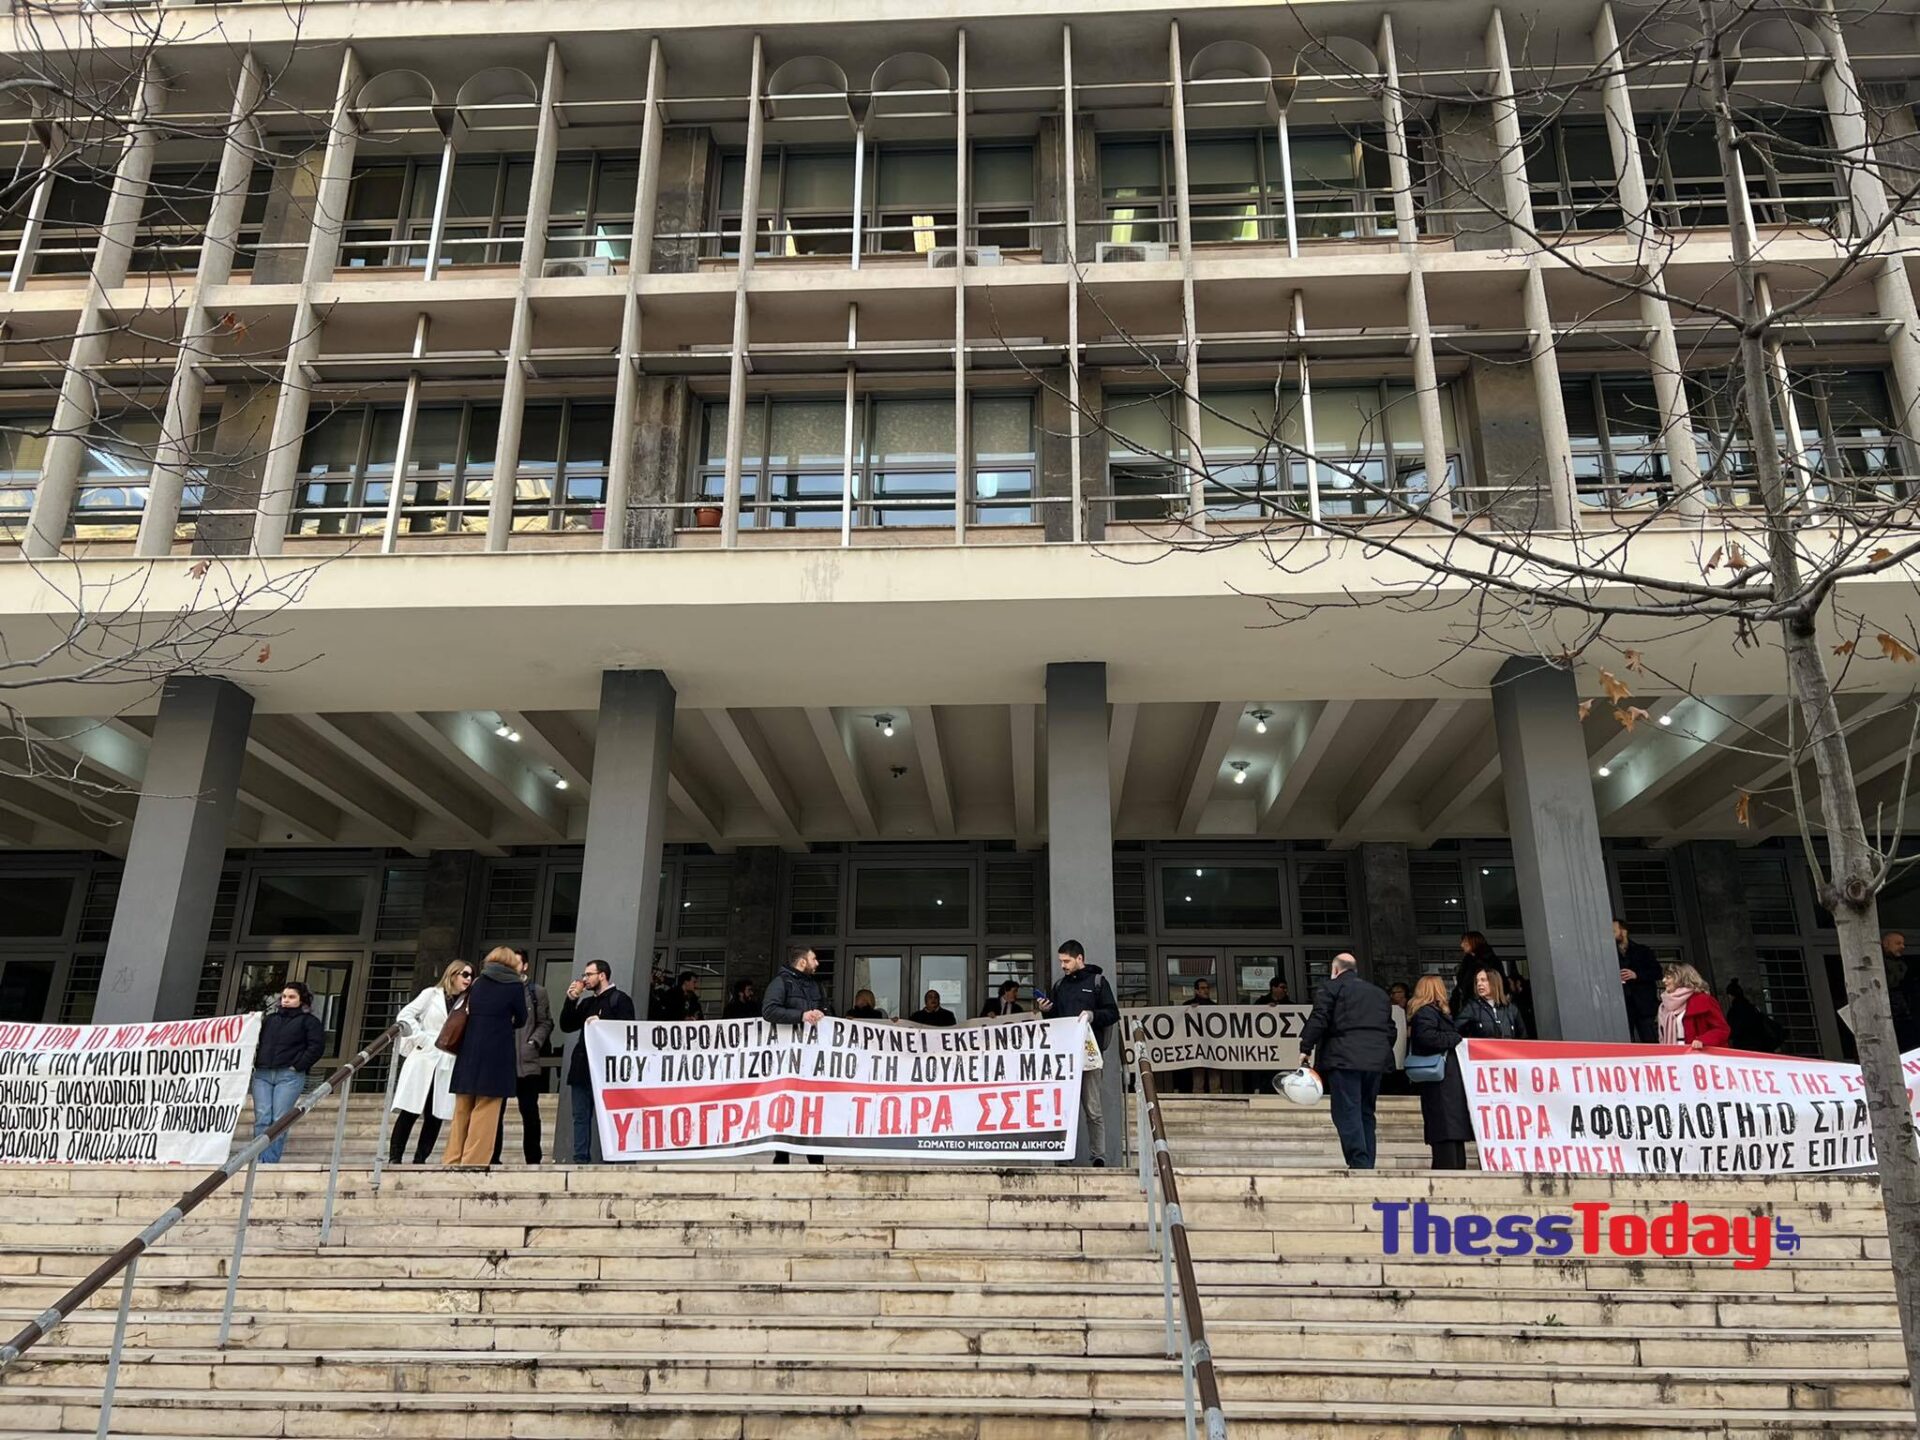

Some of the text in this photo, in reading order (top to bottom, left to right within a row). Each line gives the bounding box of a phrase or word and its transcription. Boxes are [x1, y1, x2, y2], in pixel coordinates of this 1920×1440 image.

[82, 1026, 109, 1050] ΤΟ
[105, 1025, 145, 1049] ΝΕΟ
[626, 1020, 1051, 1053] Η ΦΟΡΟΛΟΓΙΑ ΝΑ ΒΑΡΥΝΕΙ ΕΚΕΙΝΟΥΣ
[48, 1052, 81, 1076] ΤΗΝ
[83, 1051, 142, 1076] ΜΑΥΡΗ
[147, 1048, 241, 1075] ΠΡΟΟΠΤΙΚΗ
[605, 1049, 1075, 1083] ΠΟΥ ΠΛΟΥΤΙΖΟΥΝ ΑΠΟ ΤΗ ΔΟΥΛΕΙΑ ΜΑΣ!
[1151, 1044, 1280, 1063] ΘΕΣΣΑΛΟΝΙΚΗΣ
[1476, 1067, 1517, 1093] ΔΕΝ
[1531, 1066, 1560, 1093] ΘΑ
[1572, 1065, 1681, 1093] ΓΙΝΟΥΜΕ
[1693, 1064, 1781, 1094] ΘΕΑΤΕΣ
[1787, 1072, 1836, 1094] ΤΗΣ
[613, 1088, 1063, 1151] ΥΠΟΓΡΑΦΗ ΤΩΡΑ ΣΣΕ!
[1478, 1104, 1553, 1140] ΤΩΡΑ
[1570, 1101, 1797, 1140] ΑΦΟΡΟΛΟΓΗΤΟ
[917, 1140, 966, 1149] ΣΩΜΑΤΕΙΟ
[968, 1140, 1019, 1149] ΜΙΣΘΩΤΩΝ
[1484, 1145, 1625, 1173] ΚΑΤΑΡΓΗΣΗ
[1637, 1146, 1683, 1173] ΤΟΥ
[1701, 1142, 1795, 1172] ΤΕΛΟΥΣ
